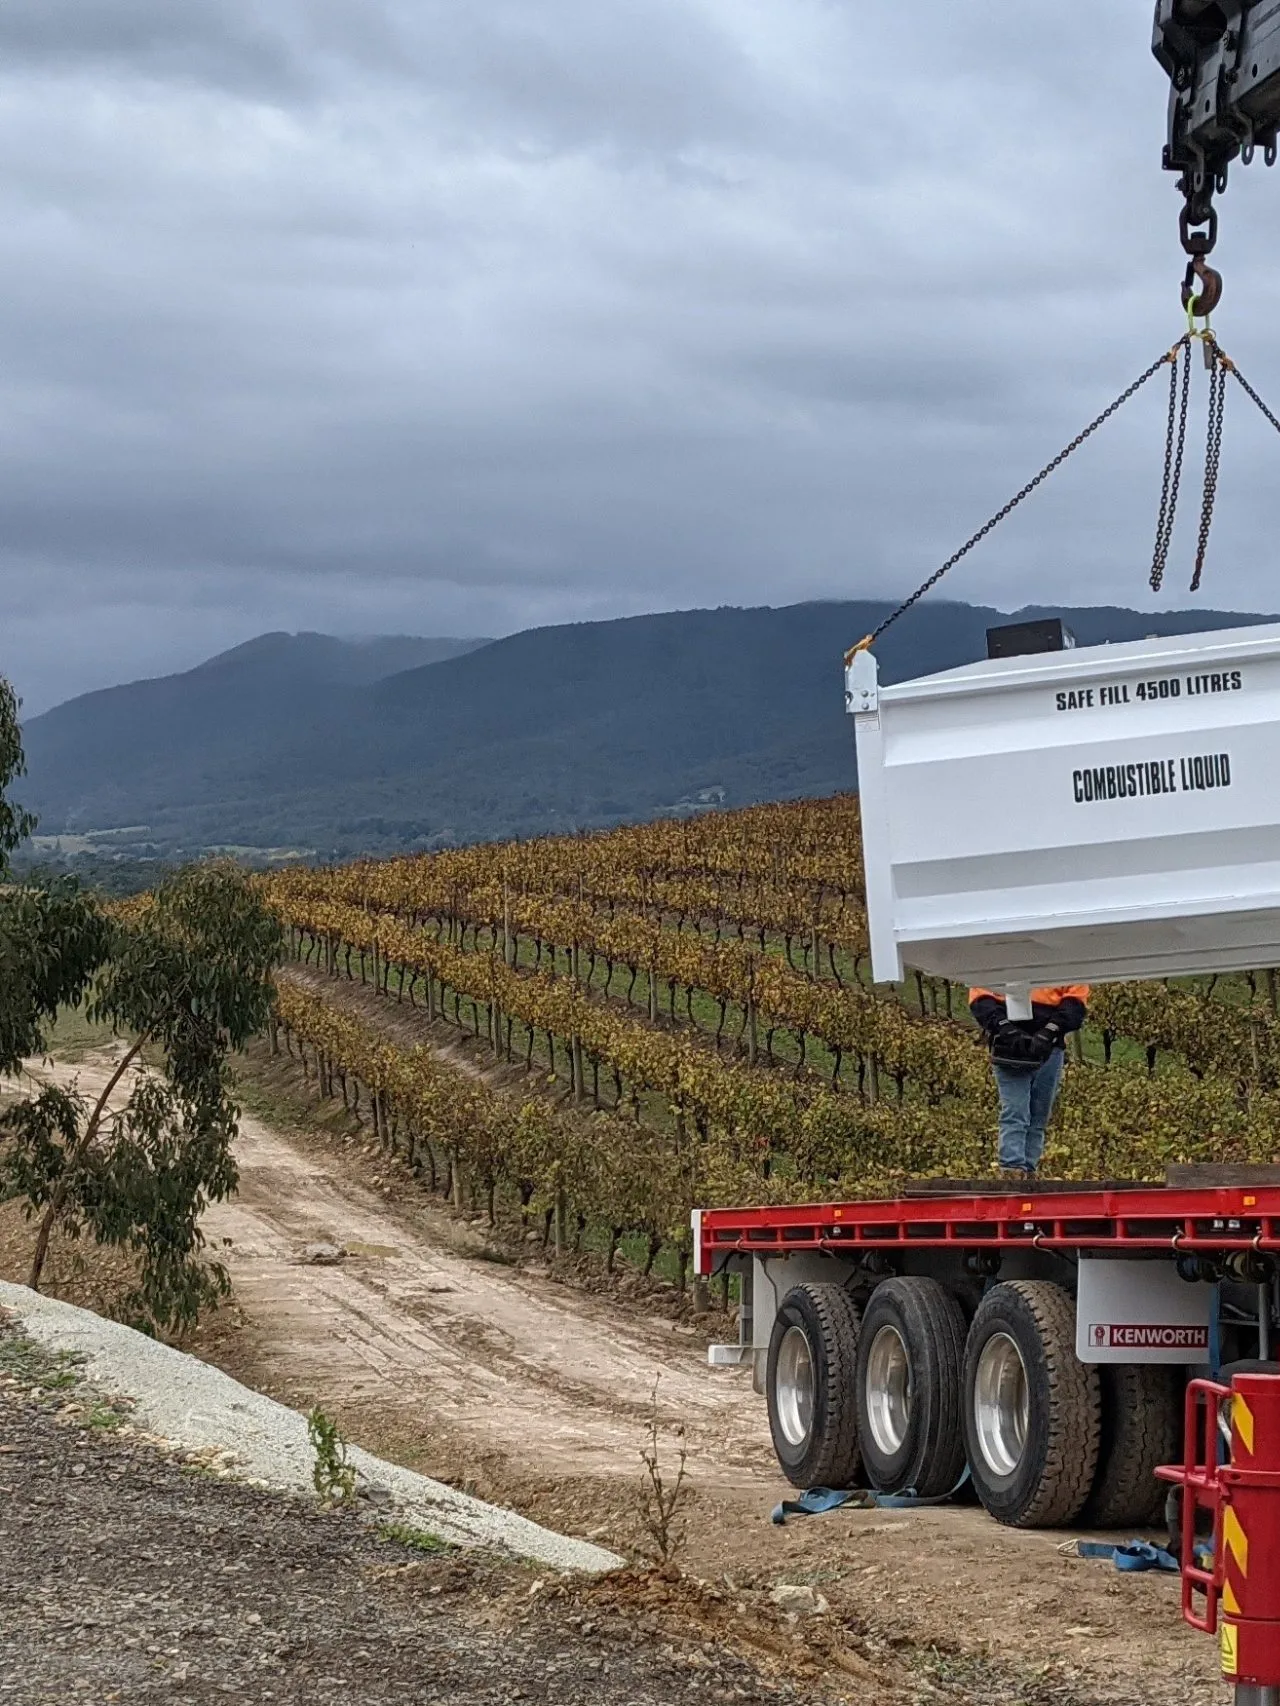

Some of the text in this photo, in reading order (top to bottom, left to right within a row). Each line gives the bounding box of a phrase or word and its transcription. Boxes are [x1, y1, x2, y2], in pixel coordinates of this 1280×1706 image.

[1056, 671, 1242, 711] SAFE FILL 4500 LITRES
[1073, 753, 1231, 802] COMBUSTIBLE LIQUID
[1113, 1328, 1205, 1344] KENWORTH
